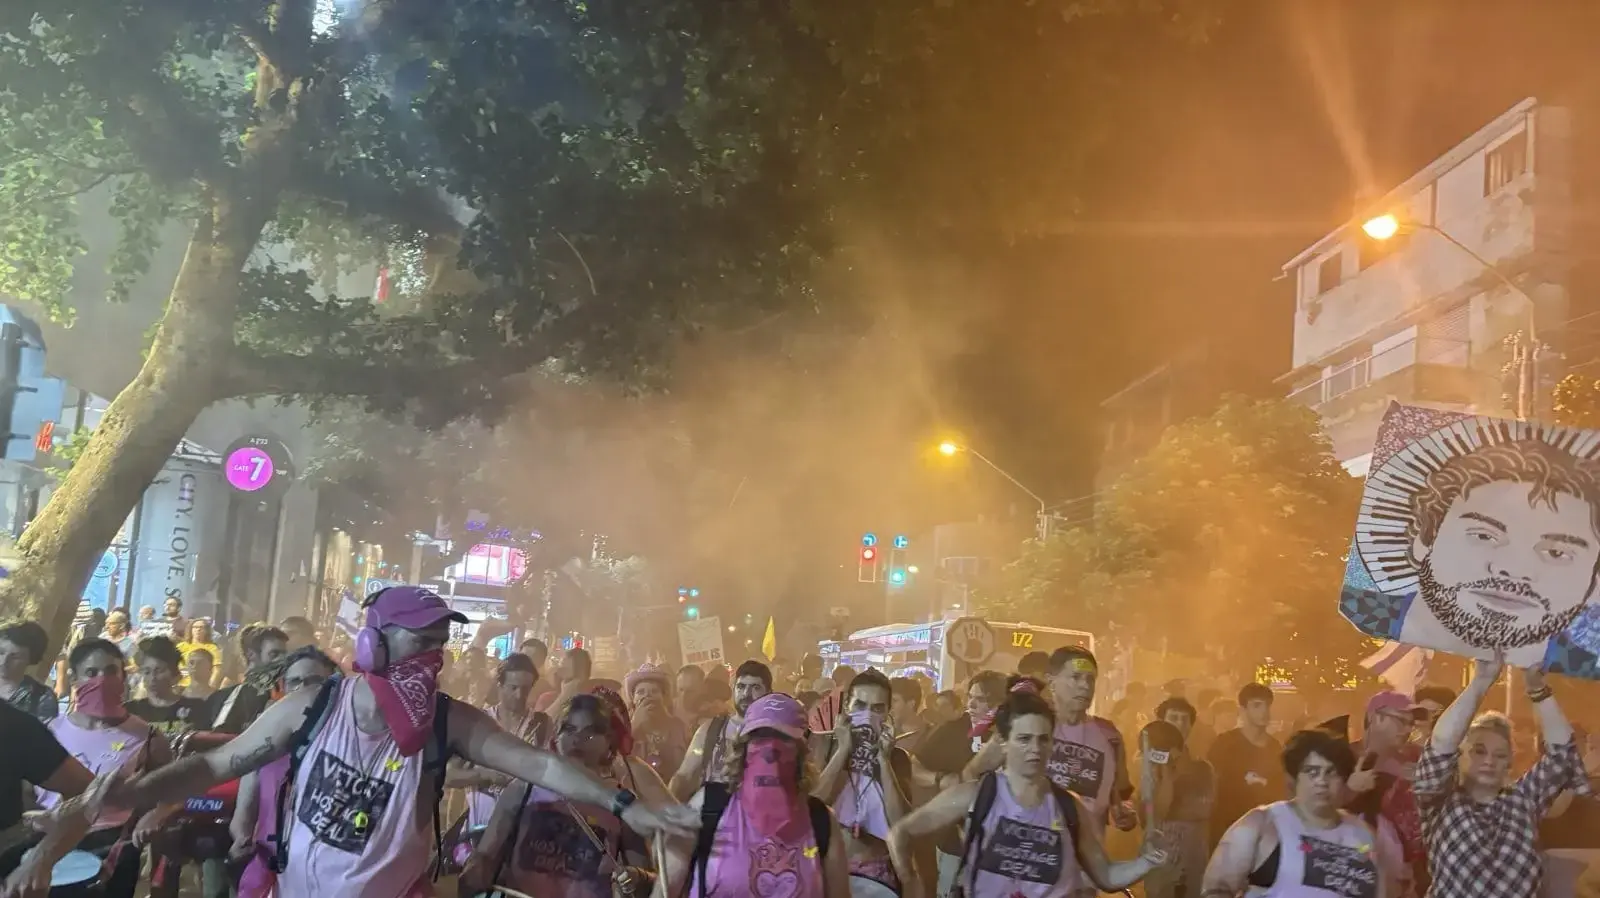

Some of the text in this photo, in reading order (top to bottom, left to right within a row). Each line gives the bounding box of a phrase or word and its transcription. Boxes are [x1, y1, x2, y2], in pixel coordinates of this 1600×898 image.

[234, 456, 267, 481] GATE 7
[166, 526, 191, 580] LOVE.
[164, 586, 182, 598] S
[1011, 631, 1034, 648] 172
[999, 860, 1041, 878] DEAL
